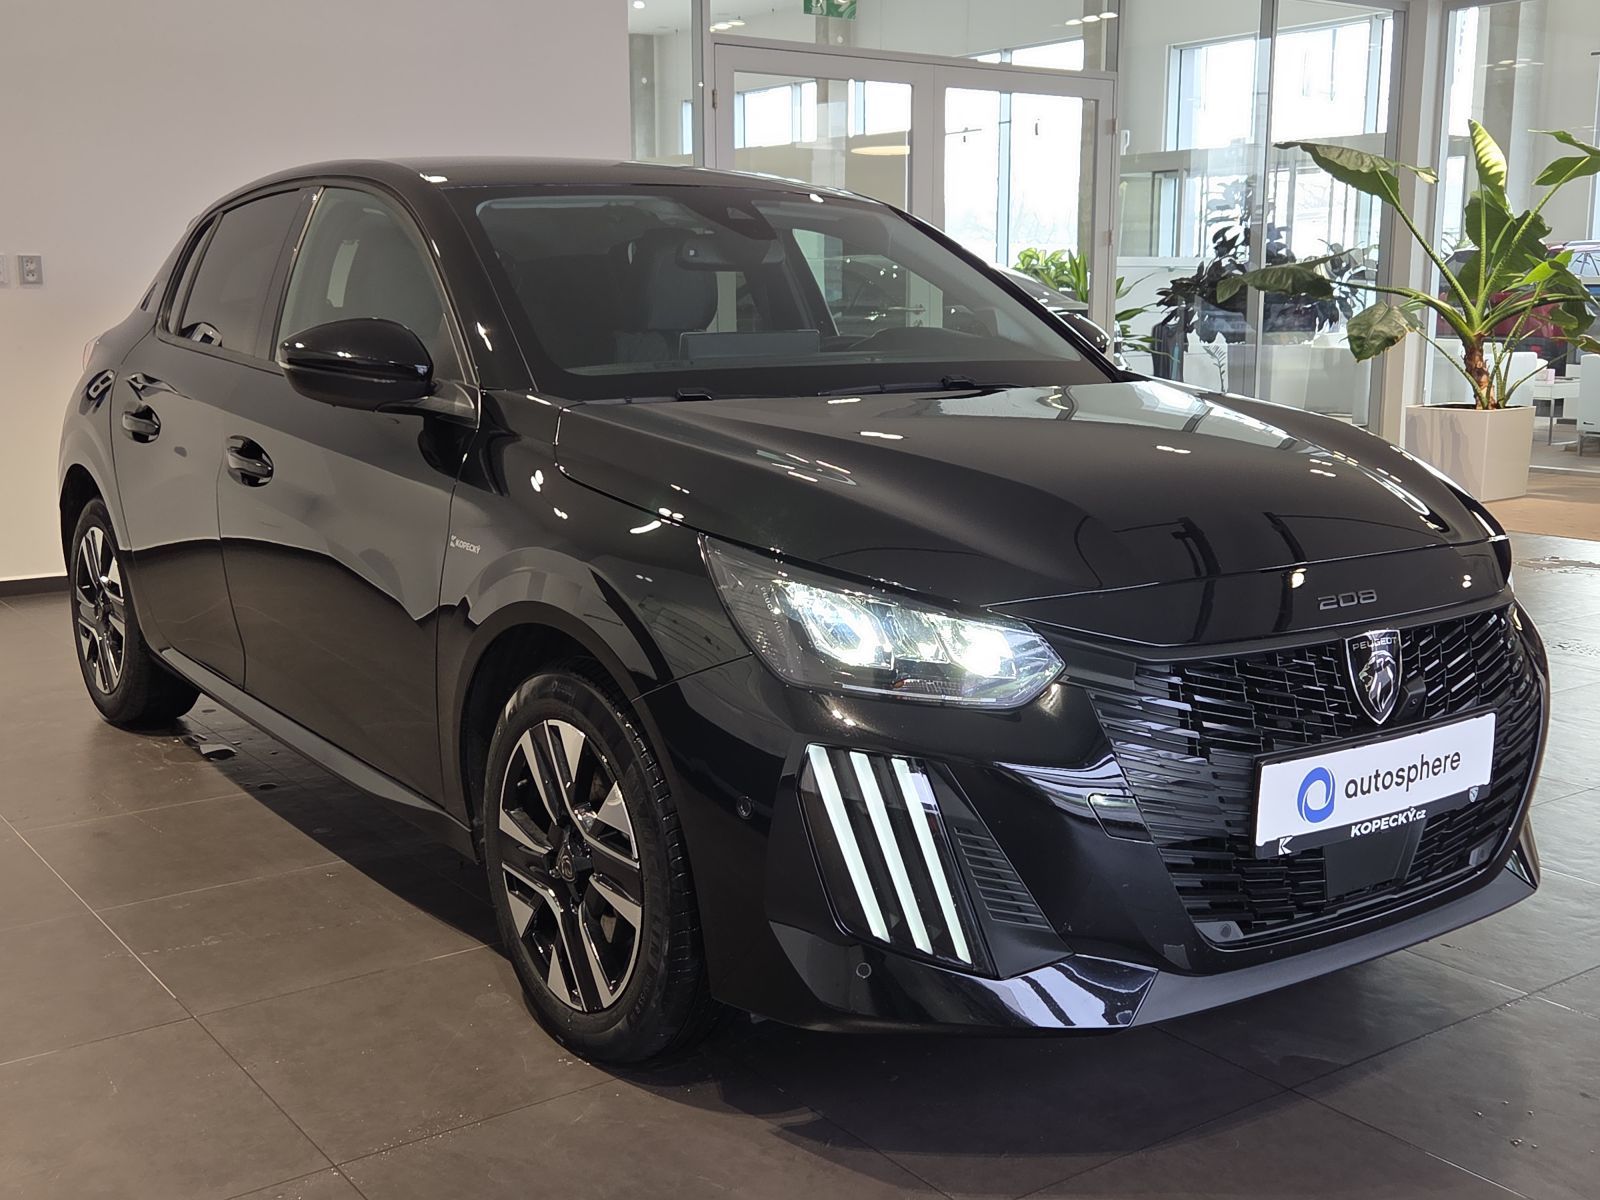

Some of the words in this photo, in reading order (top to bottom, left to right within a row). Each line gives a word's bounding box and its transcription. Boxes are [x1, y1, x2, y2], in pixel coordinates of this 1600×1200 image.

[1317, 589, 1378, 610] 208
[1352, 636, 1397, 651] PEUGEOT
[1344, 751, 1461, 799] autosphere
